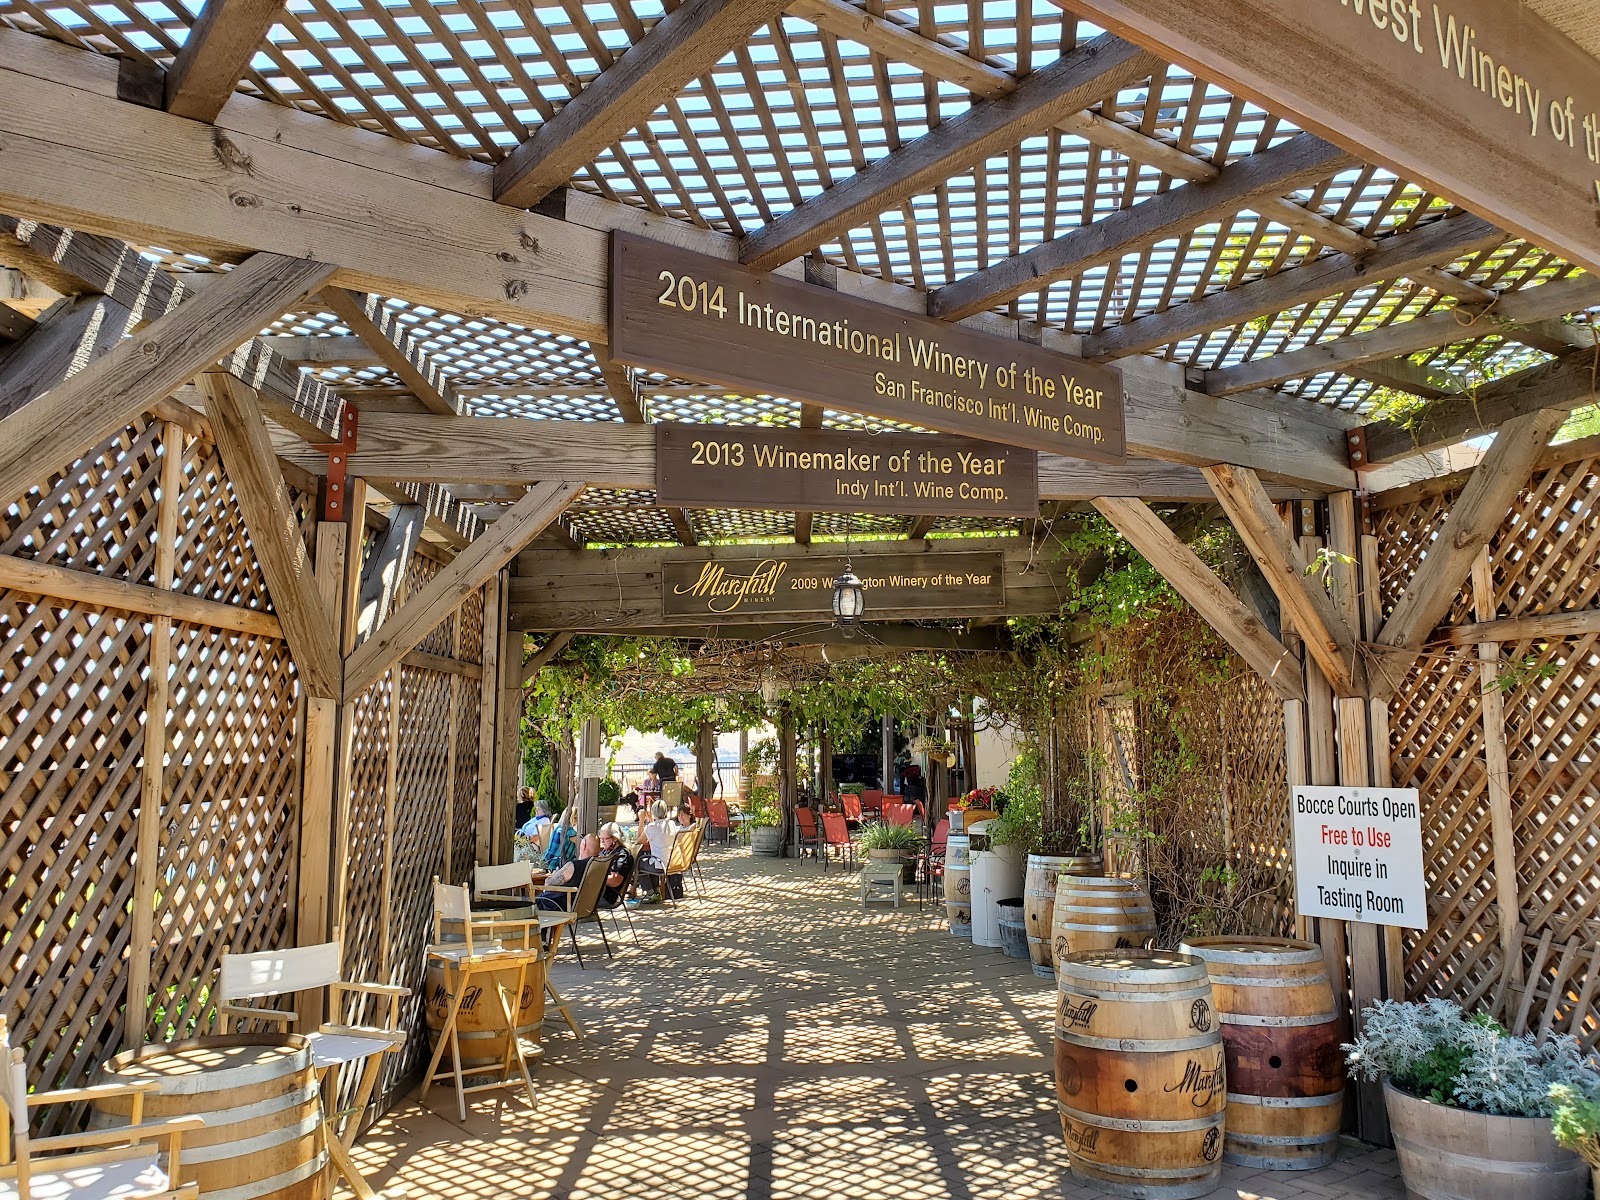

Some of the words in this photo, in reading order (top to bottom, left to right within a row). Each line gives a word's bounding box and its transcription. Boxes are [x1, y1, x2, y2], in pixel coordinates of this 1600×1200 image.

[1433, 4, 1540, 136] Winery
[1550, 96, 1575, 148] of
[658, 270, 728, 320] 2014
[738, 291, 901, 363] International
[907, 336, 989, 390] Winery
[996, 362, 1017, 390] of
[1023, 366, 1056, 399] the
[1061, 374, 1103, 410] Year
[875, 372, 906, 400] San
[911, 380, 984, 417] Francisco
[1023, 405, 1060, 432] Wine
[1063, 414, 1106, 444] Comp.
[690, 440, 745, 467] 2013
[752, 443, 880, 472] Winemaker
[888, 449, 911, 473] of
[917, 450, 953, 475] the
[956, 451, 1006, 475] Year
[835, 478, 870, 500] Indy
[913, 480, 954, 499] Wine
[958, 481, 1009, 504] Comp.
[673, 559, 787, 613] Maryhill
[790, 577, 818, 590] 2009
[821, 576, 886, 590] Wgton
[889, 575, 928, 589] Winery
[931, 574, 943, 586] of
[944, 573, 963, 585] the
[965, 573, 991, 585] Year
[1297, 794, 1334, 815] Bocce
[1338, 795, 1379, 817] Courts
[1382, 797, 1416, 822] Open
[1321, 824, 1348, 845] Free
[1351, 826, 1364, 846] to
[1367, 827, 1391, 848] Use
[1327, 855, 1372, 880] Inquire
[1375, 858, 1388, 879] in
[1317, 885, 1363, 913] Tasting
[1366, 890, 1404, 914] Room
[428, 984, 482, 1018] Mahill
